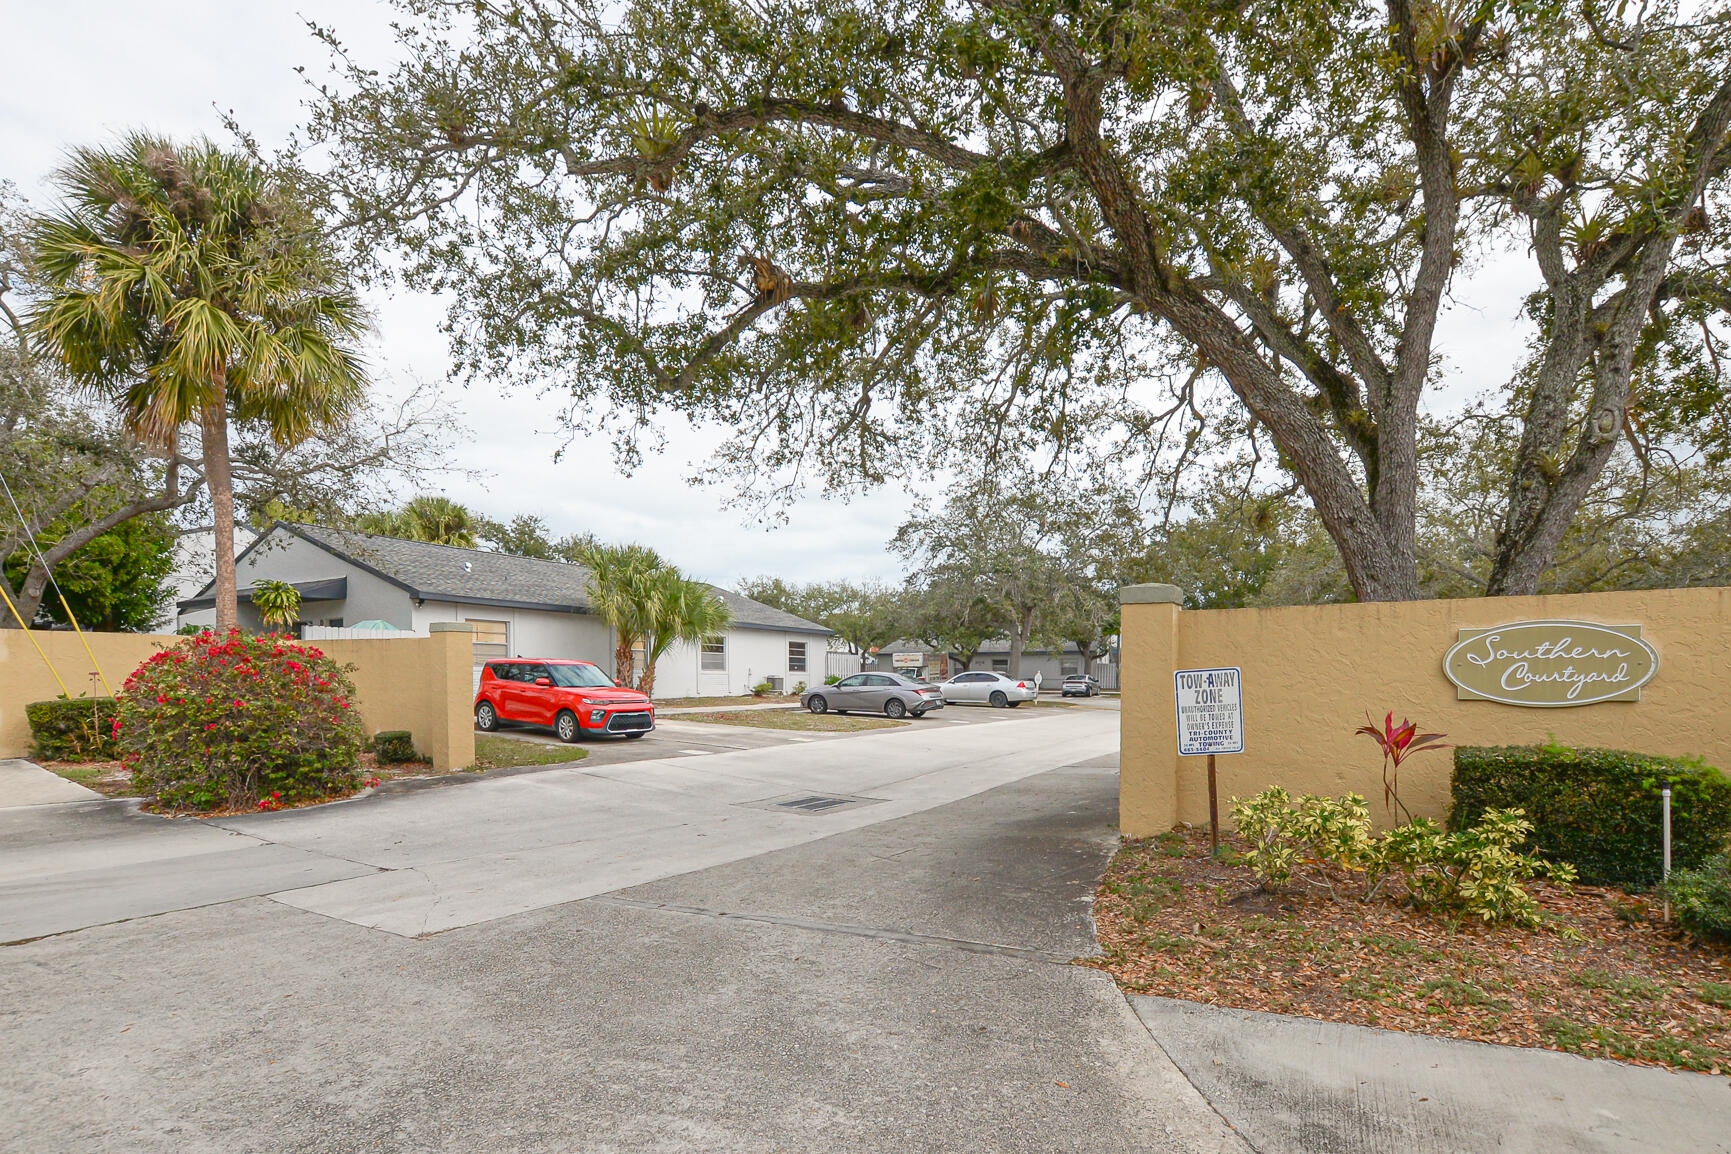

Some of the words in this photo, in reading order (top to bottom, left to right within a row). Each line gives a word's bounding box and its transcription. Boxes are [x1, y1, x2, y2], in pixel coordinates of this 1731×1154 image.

[1467, 635, 1630, 668] Southern
[1180, 672, 1235, 689] TOW-AWAY
[1501, 662, 1630, 699] Courtyard
[1195, 689, 1223, 704] ZONE
[1181, 705, 1216, 714] UNAUTHORIZED
[1217, 703, 1237, 712] VEHICLES
[1186, 714, 1198, 722] WILL
[1208, 713, 1225, 721] TOWED
[1228, 712, 1234, 720] AT
[1187, 722, 1210, 730] OWNER'S
[1212, 721, 1234, 729] EXPENSE
